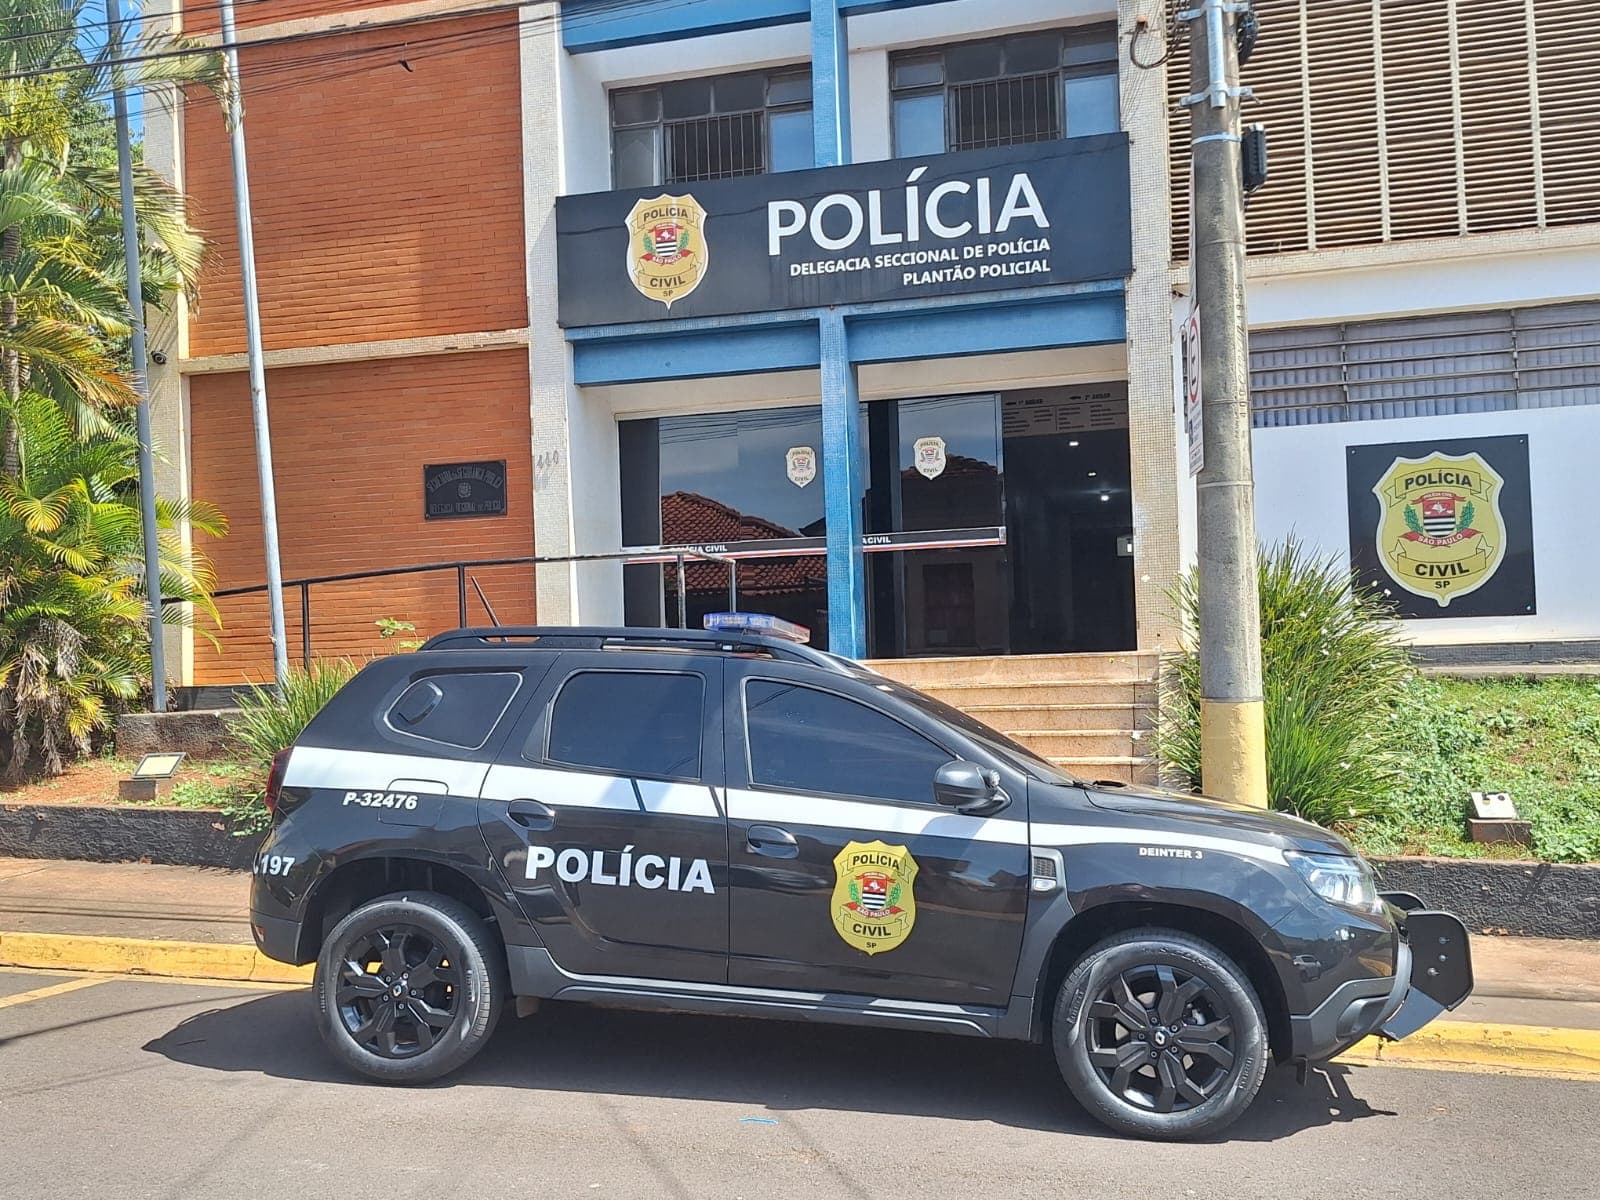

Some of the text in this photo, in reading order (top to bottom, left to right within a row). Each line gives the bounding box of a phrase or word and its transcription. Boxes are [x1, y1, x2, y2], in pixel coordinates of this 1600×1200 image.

[768, 166, 1050, 255] POLÍCIA
[790, 237, 1050, 276] DELEGACIA SECCIONAL DE POLÍCIA
[903, 259, 1050, 285] PLANTÃO POLICIAL
[650, 276, 686, 287] CIVIL
[1404, 469, 1472, 490] POLÍCIA
[867, 536, 891, 544] CIVIL
[1437, 533, 1463, 545] PAULO
[1415, 562, 1470, 577] CIVIL
[1435, 580, 1450, 589] SP
[342, 792, 418, 810] P-32476
[1139, 847, 1203, 859] DEINTER 3
[261, 855, 296, 876] 197
[525, 845, 716, 894] POLÍCIA
[853, 924, 891, 936] CIVIL
